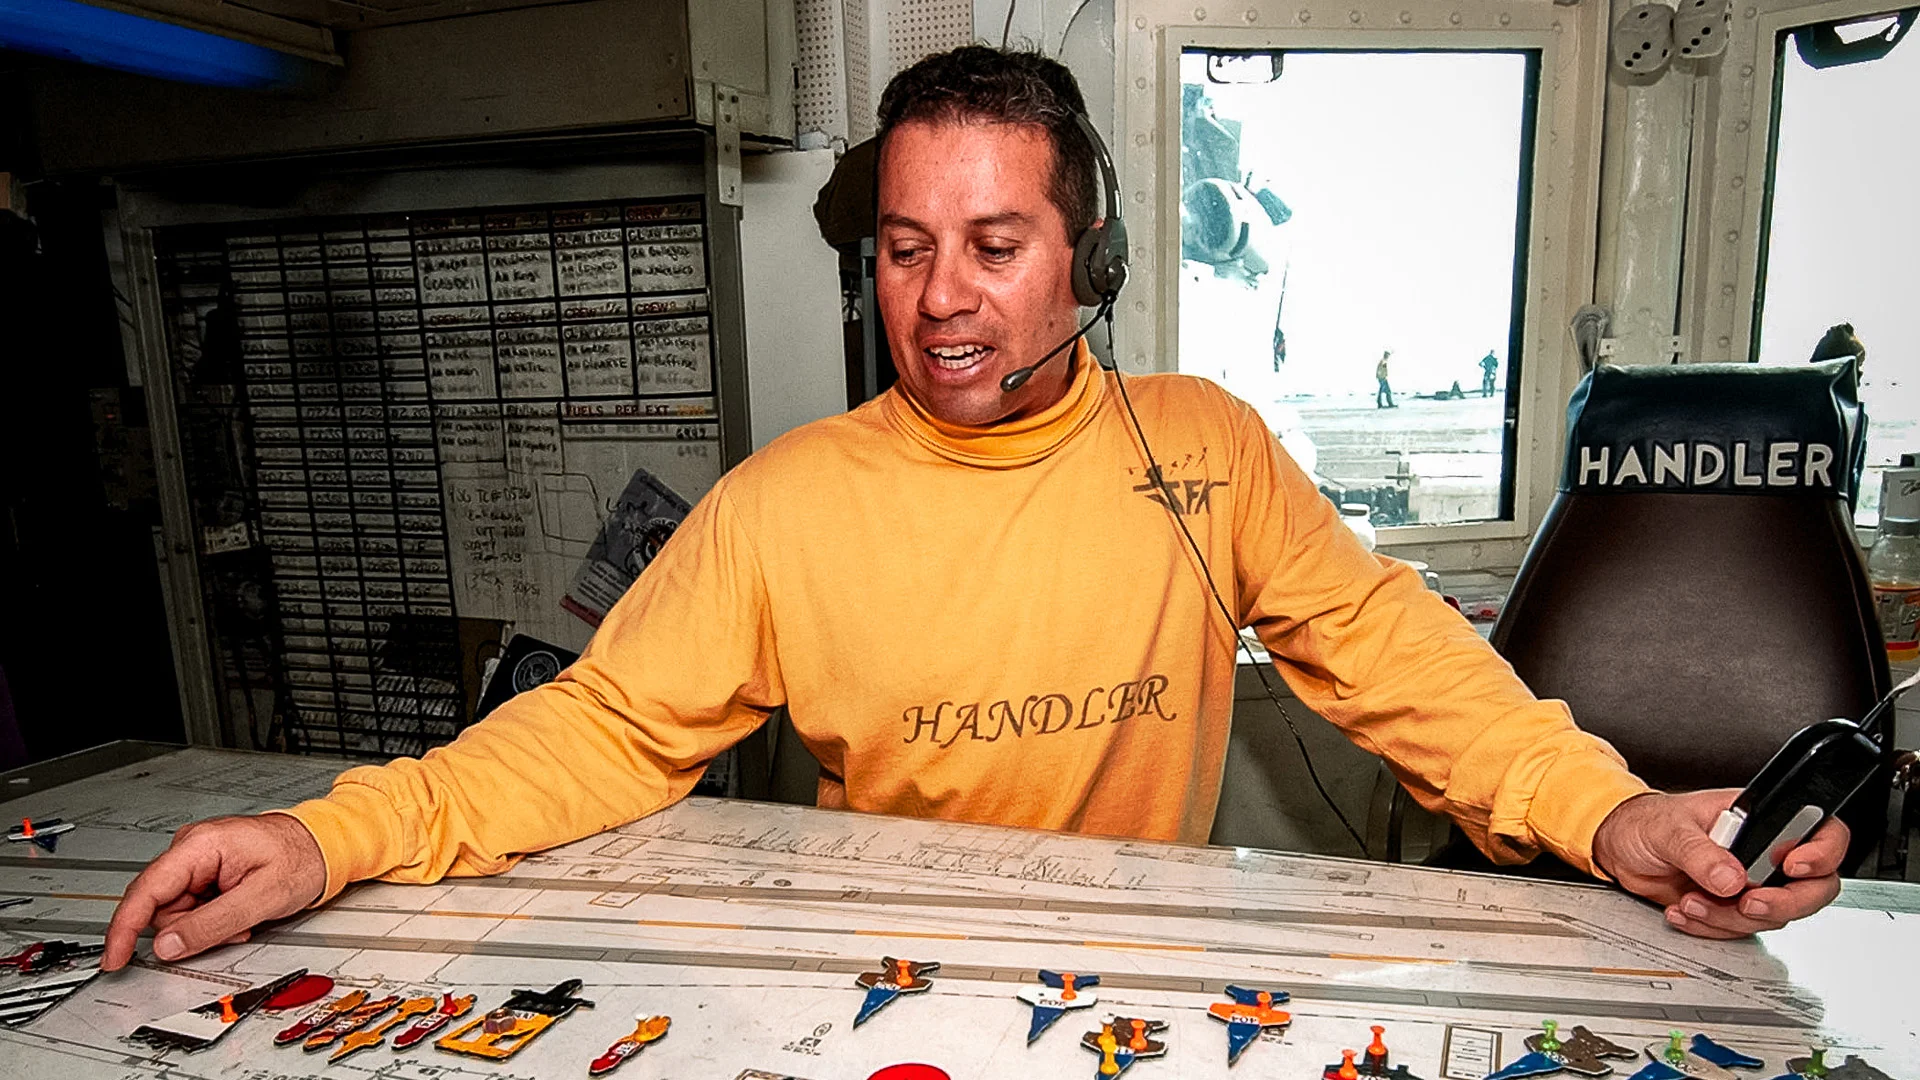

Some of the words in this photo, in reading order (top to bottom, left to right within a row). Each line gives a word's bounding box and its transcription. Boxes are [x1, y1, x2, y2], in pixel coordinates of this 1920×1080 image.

[566, 404, 604, 417] FUELS
[646, 404, 670, 415] EXT
[1578, 442, 1834, 487] HANDLER
[902, 673, 1178, 750] HANDLER
